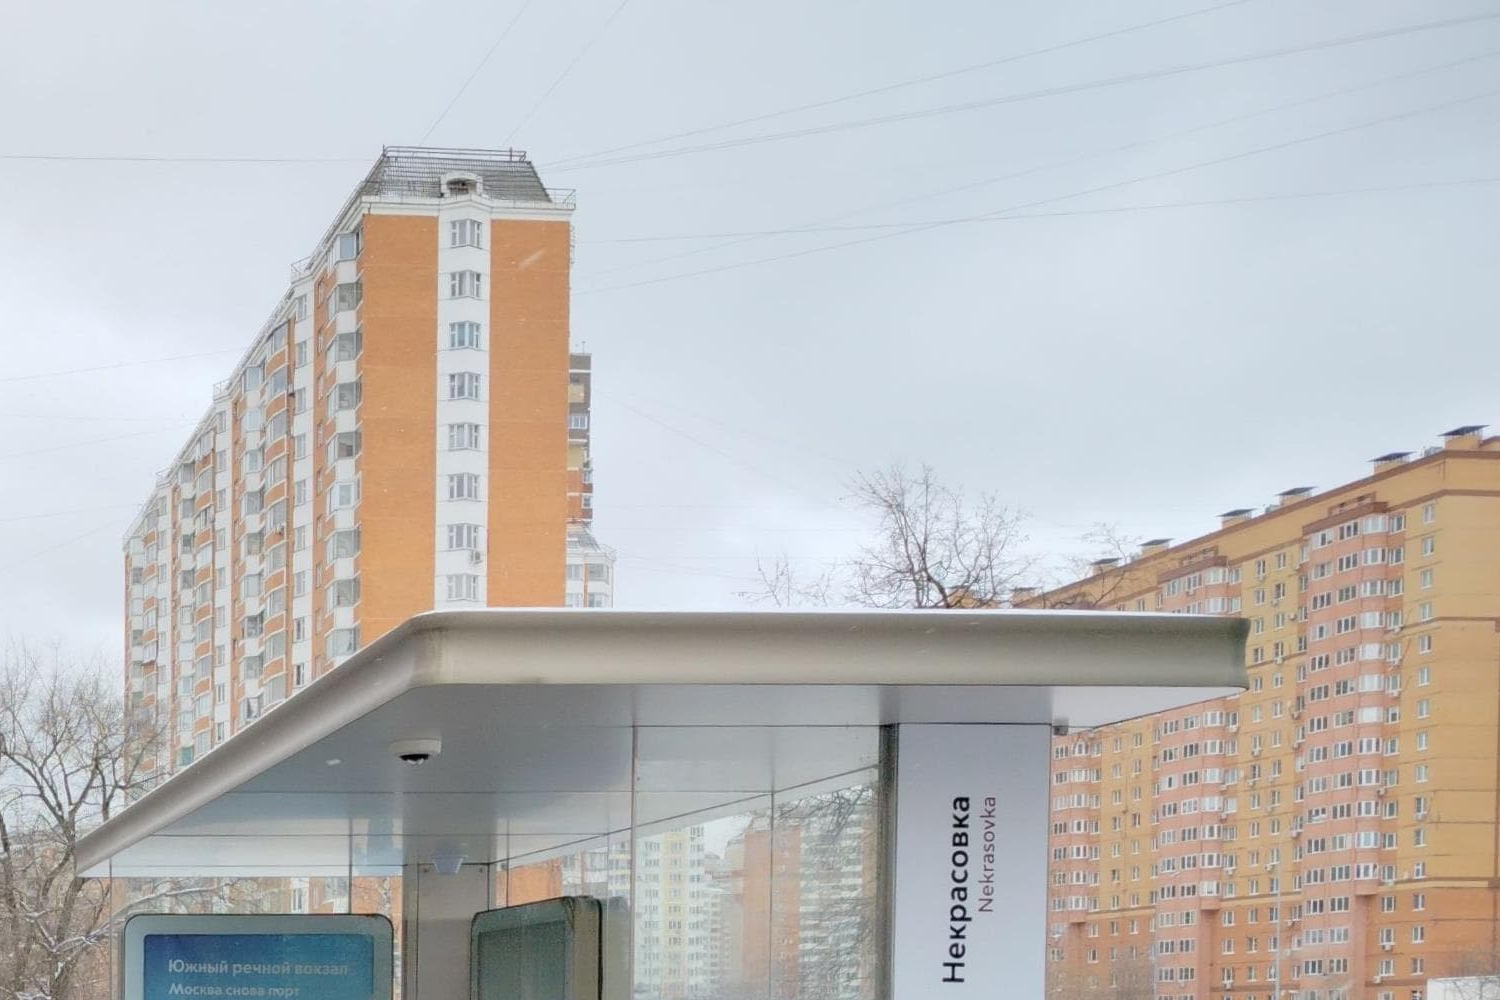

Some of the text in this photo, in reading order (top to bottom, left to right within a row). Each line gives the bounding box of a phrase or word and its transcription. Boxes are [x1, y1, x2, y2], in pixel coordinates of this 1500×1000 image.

[978, 796, 996, 912] Nekrasovka
[942, 796, 972, 983] Некрасовка
[168, 959, 348, 976] Южный речной вокзал
[168, 983, 300, 999] Москва снова порт
